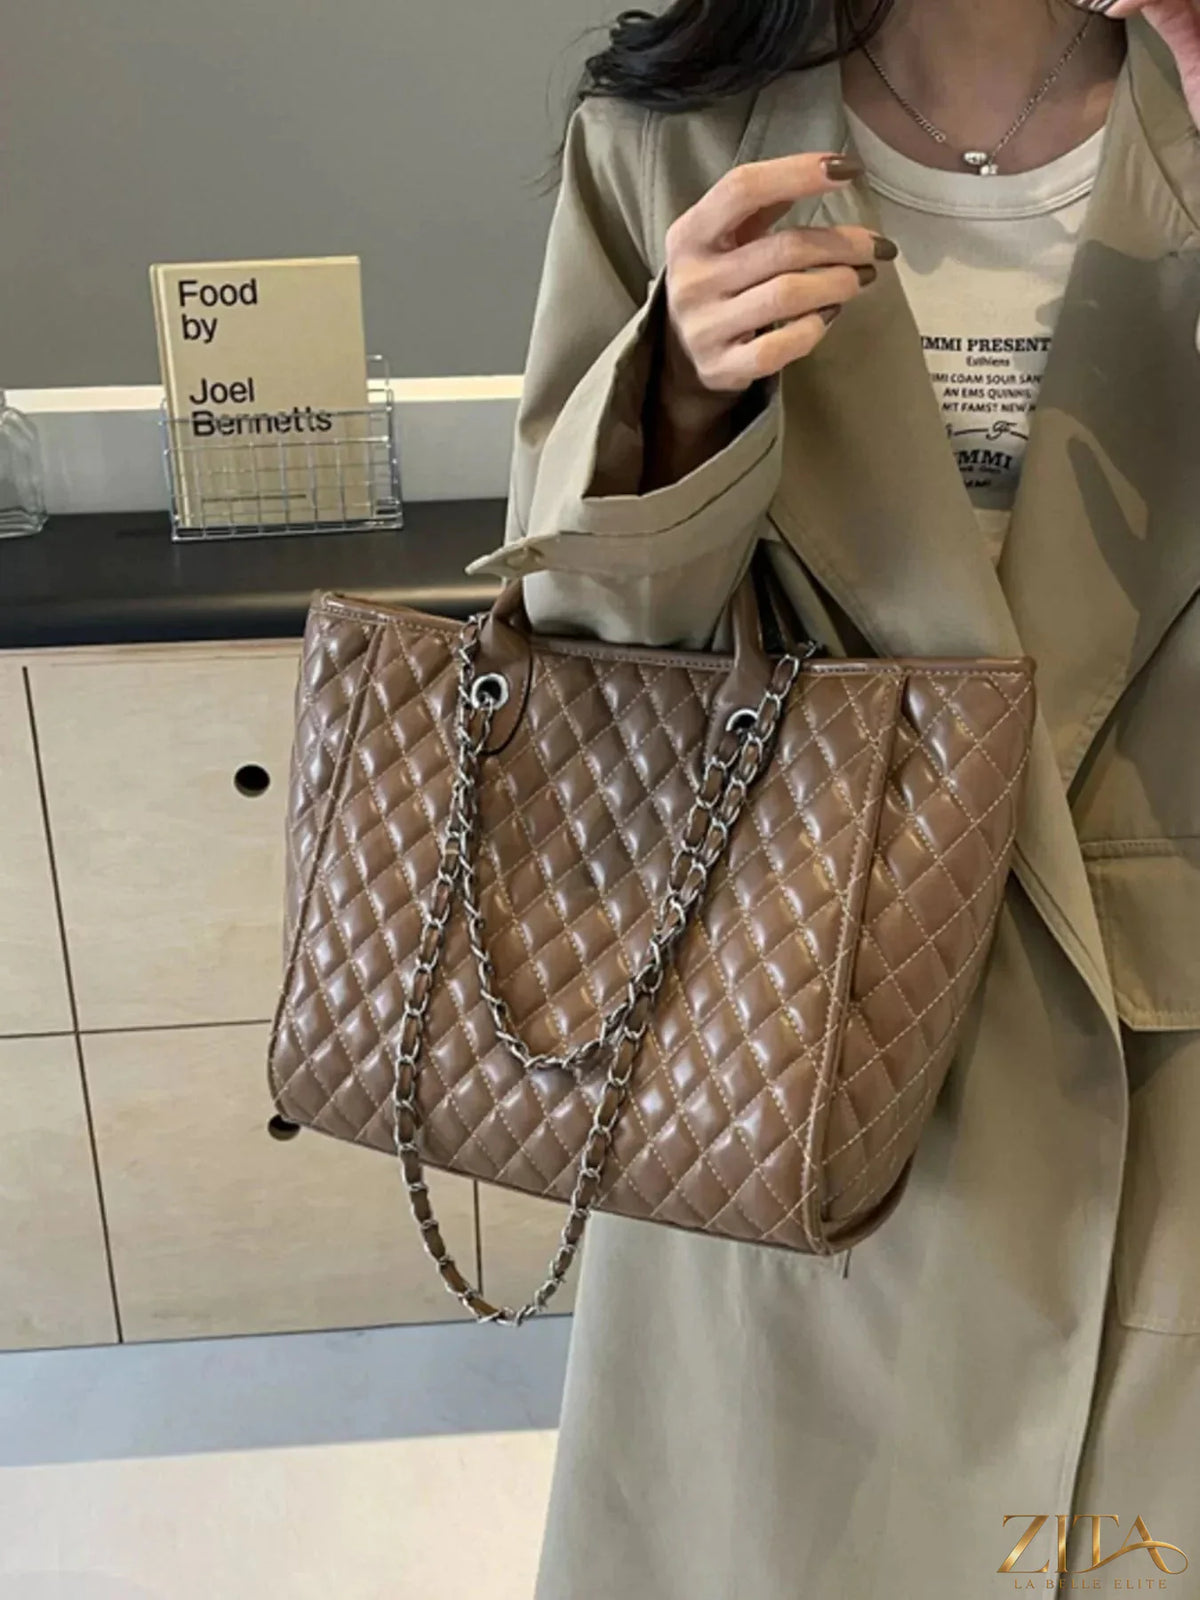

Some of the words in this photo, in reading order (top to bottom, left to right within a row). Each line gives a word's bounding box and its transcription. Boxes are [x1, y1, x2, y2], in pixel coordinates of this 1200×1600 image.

[178, 278, 258, 307] Food
[181, 313, 218, 344] by
[189, 377, 255, 405] Joel
[192, 406, 333, 437] Bennetts
[953, 449, 1013, 469] MMI
